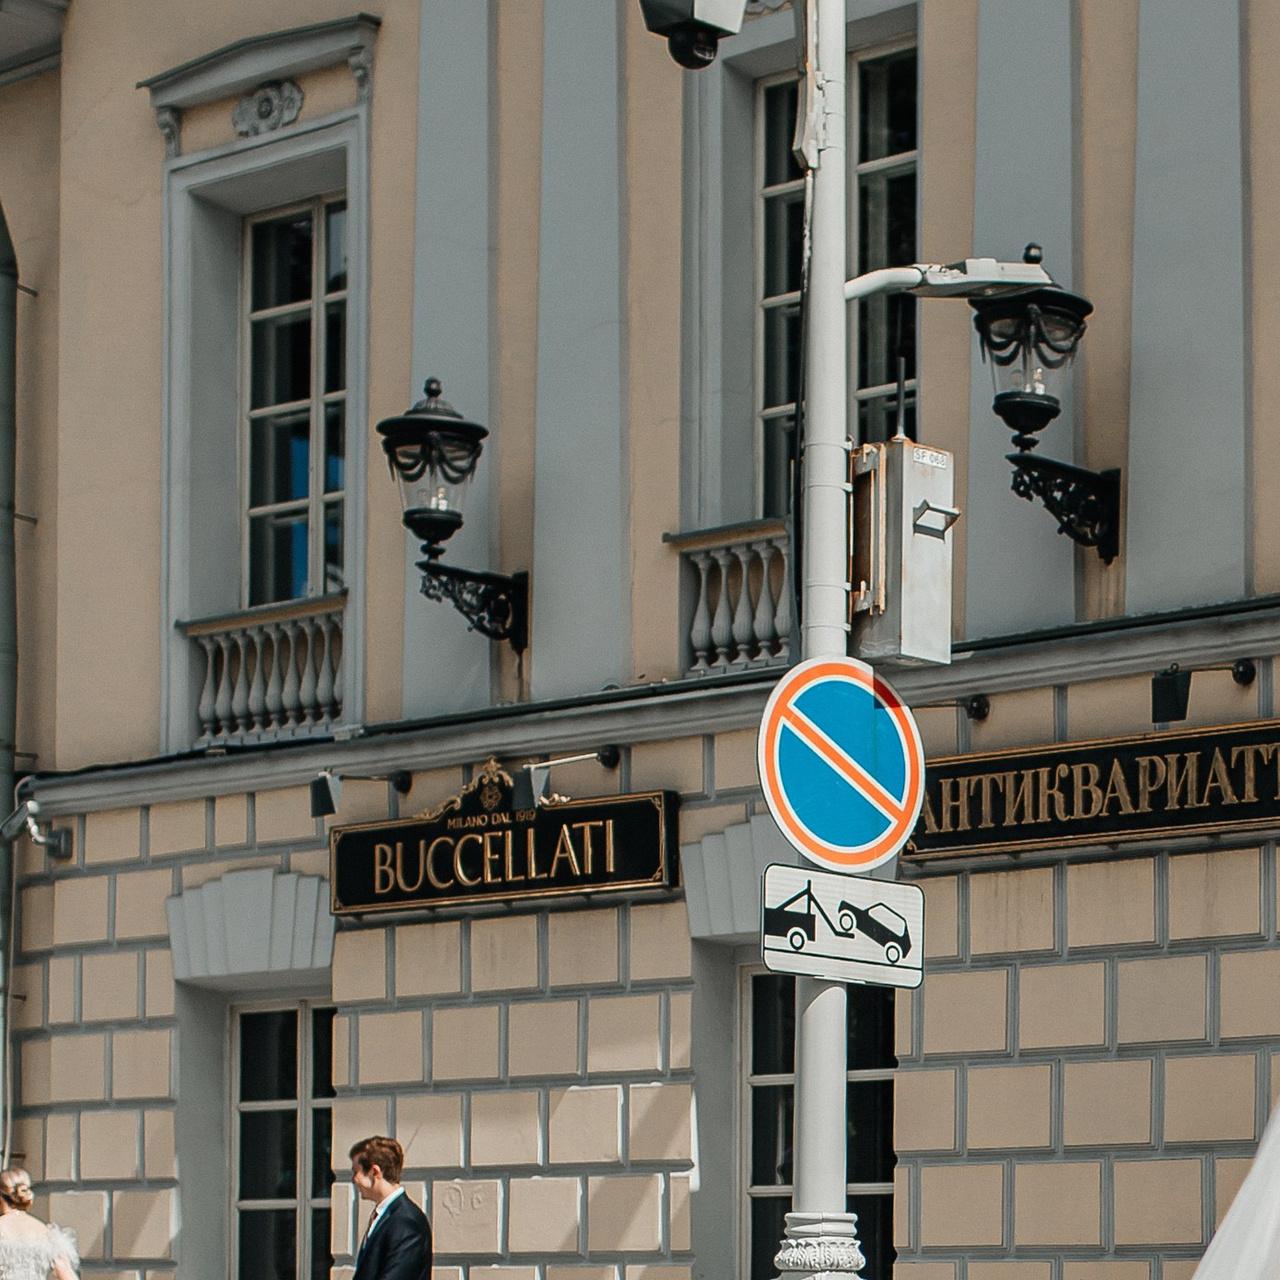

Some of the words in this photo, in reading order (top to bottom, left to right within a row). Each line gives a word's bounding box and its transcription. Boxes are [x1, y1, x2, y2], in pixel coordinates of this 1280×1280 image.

[914, 449, 926, 461] SF
[447, 815, 488, 829] MILANO
[492, 812, 512, 825] DAL
[516, 809, 536, 821] 1919
[374, 819, 615, 894] BUCCELLATI
